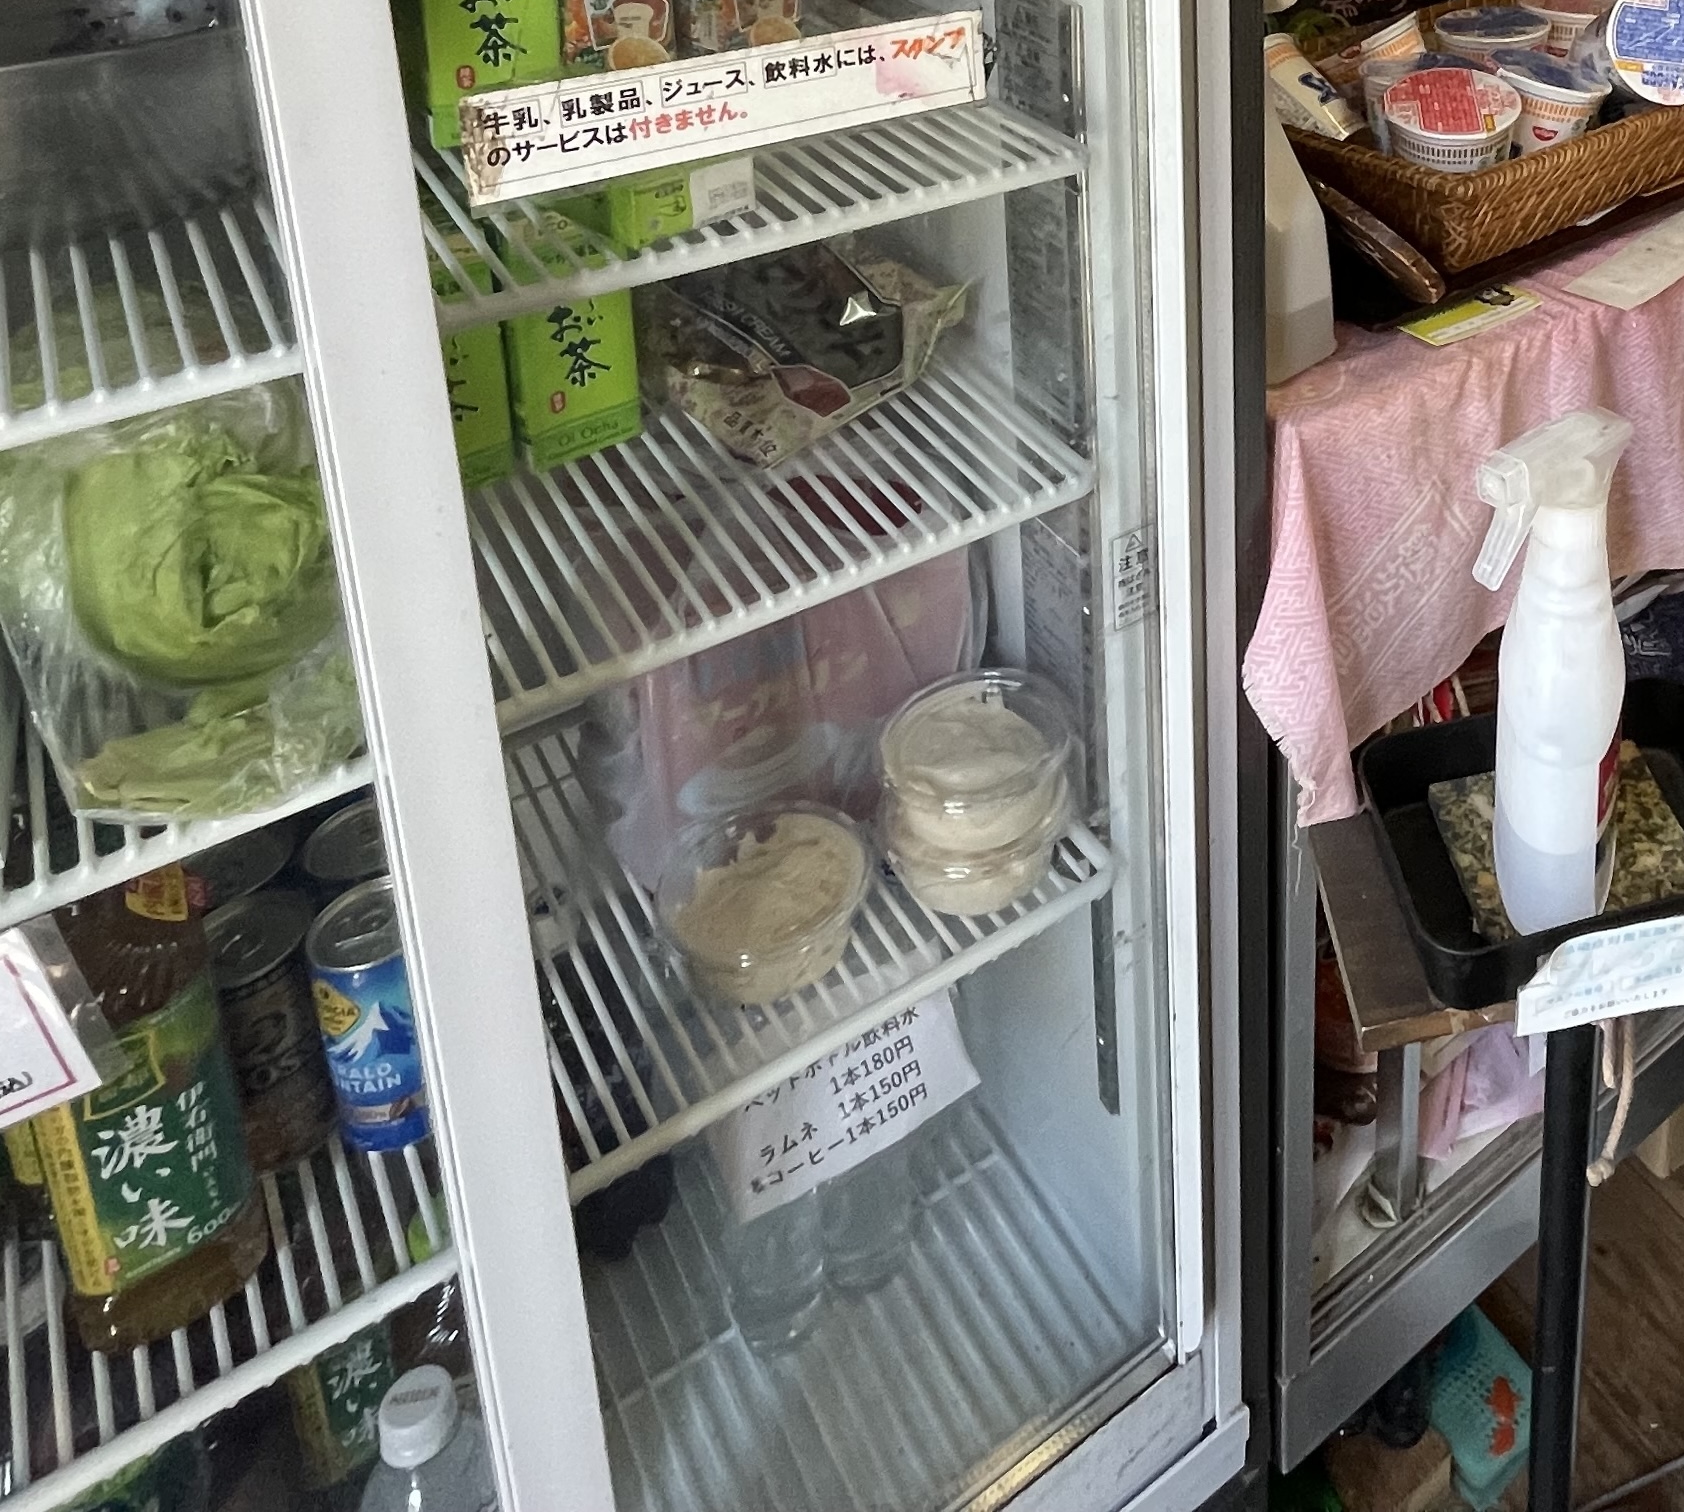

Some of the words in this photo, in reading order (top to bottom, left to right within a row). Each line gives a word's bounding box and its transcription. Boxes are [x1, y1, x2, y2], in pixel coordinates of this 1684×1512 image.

[486, 104, 751, 170] のサービスは付きません。
[546, 305, 612, 387] お茶
[829, 1034, 915, 1095] 1本180円
[760, 1121, 819, 1166] ラムネ
[837, 1059, 923, 1121] 1本150円
[91, 1104, 195, 1250] 濃い味
